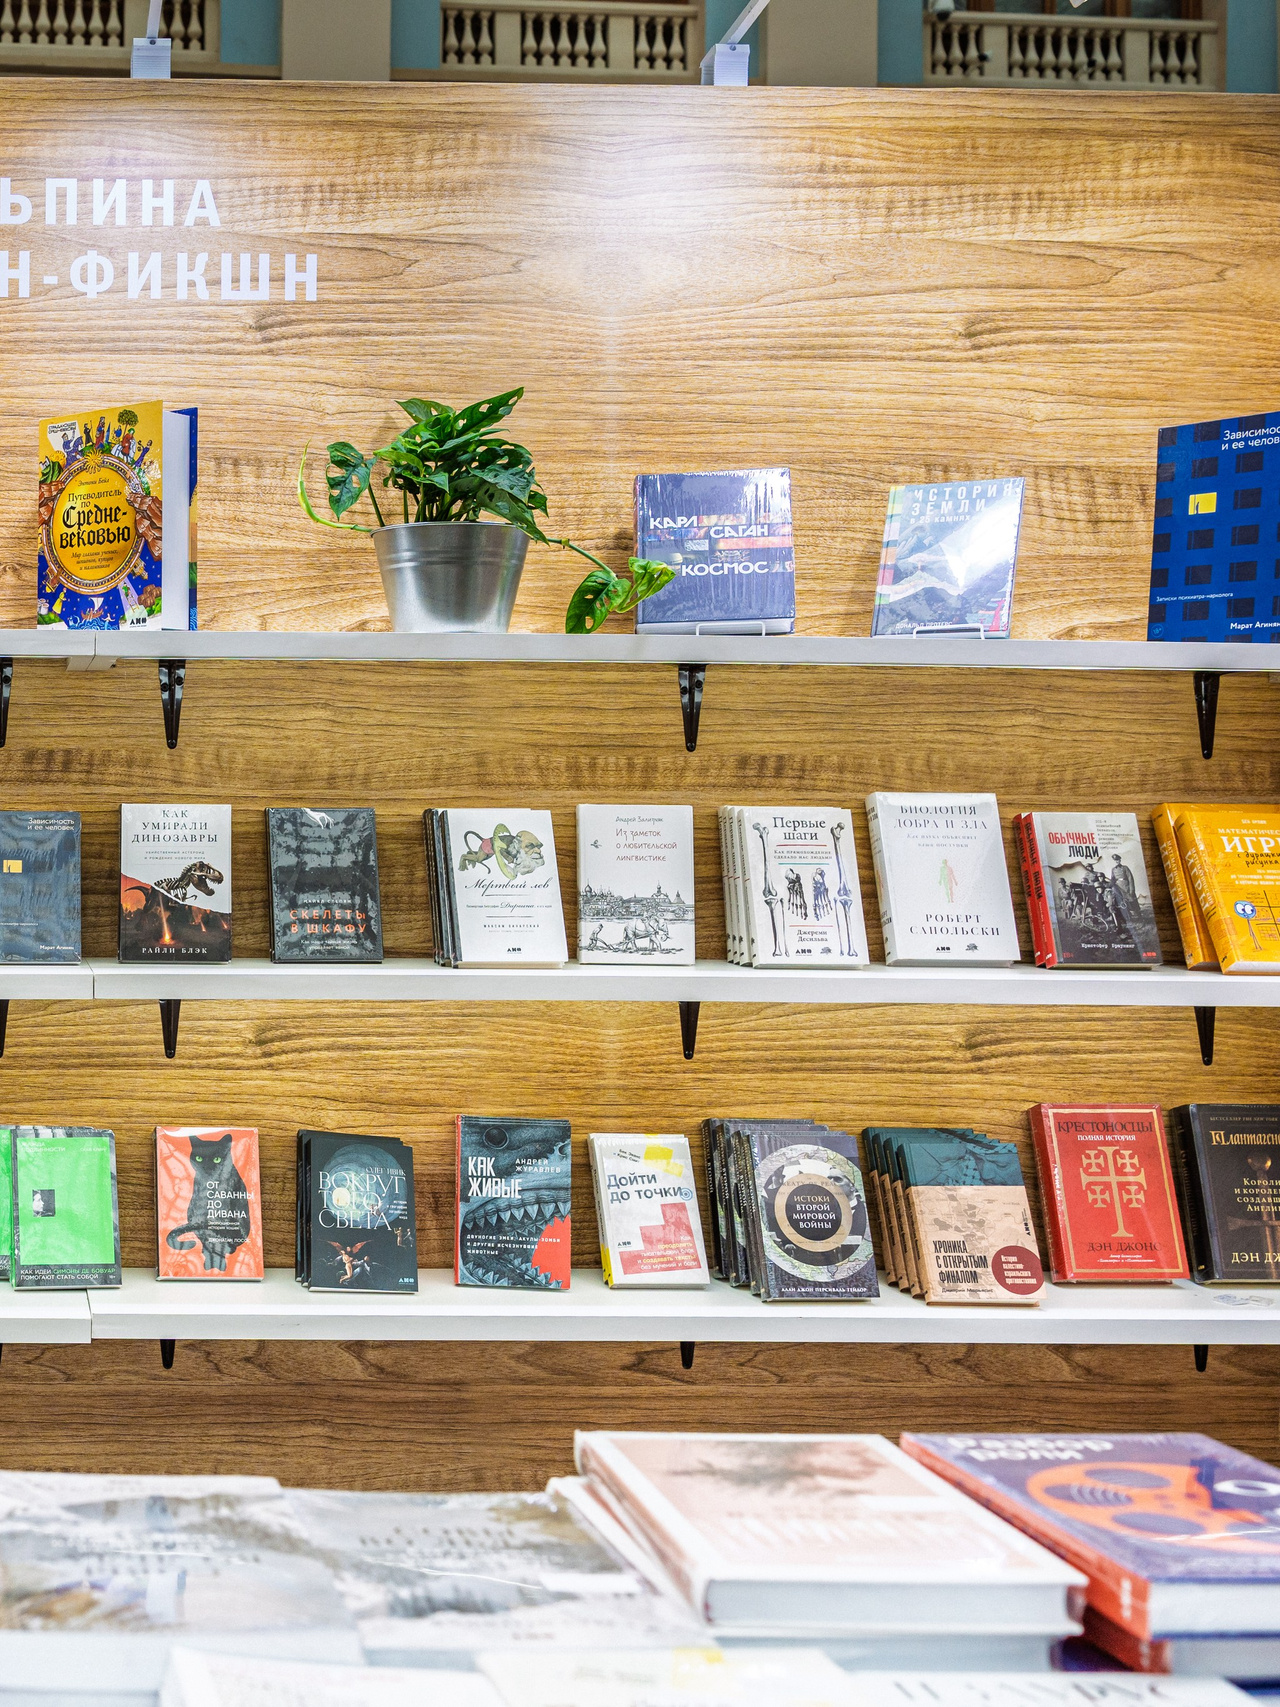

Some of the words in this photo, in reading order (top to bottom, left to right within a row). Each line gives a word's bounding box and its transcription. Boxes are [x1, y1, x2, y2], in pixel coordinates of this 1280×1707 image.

[68, 489, 122, 504] Путеводитель
[914, 484, 1013, 502] ИСТОРИЯ
[911, 499, 986, 515] ЗЕМЛИ
[62, 504, 127, 531] Средне-
[650, 515, 698, 529] КАРЛ
[934, 515, 971, 523] камнях
[709, 525, 769, 538] САГАН
[60, 526, 131, 549] вековью
[681, 561, 769, 577] КОСМОС
[1230, 621, 1253, 630] Марат
[162, 809, 189, 819] КАК
[900, 805, 977, 816] БИОЛОГИЯ
[28, 817, 75, 825] Зависимость
[142, 822, 208, 831] УМИРАЛИ
[772, 816, 827, 829] Первые
[893, 818, 939, 829] ДОБРА
[945, 819, 955, 829] И
[961, 820, 988, 830] ЗЛА
[131, 834, 218, 844] ДИНОЗАВРЫ
[615, 828, 628, 841] Из
[783, 831, 819, 842] шаги
[1048, 830, 1097, 845] ОБЫЧНЫЕ
[1068, 845, 1100, 859] ЛЮДИ
[289, 909, 366, 920] СКЕЛЕТЫ
[925, 913, 982, 924] РОБЕРТ
[291, 923, 299, 934] В
[307, 923, 366, 934] ШКАФУ
[909, 925, 1001, 936] САПОЛЬСКИ
[142, 946, 175, 954] РАЙЛИ
[1058, 1121, 1153, 1133] КРЕСТОНОСЦЫ
[468, 1156, 496, 1177] КАК
[515, 1157, 549, 1166] АНДРЕЙ
[366, 1166, 384, 1174] ОЛЕГ
[386, 1168, 406, 1176] ИВИК
[515, 1165, 561, 1174] ЖУРАВЛЕВ
[206, 1181, 220, 1189] ОТ
[318, 1171, 406, 1197] ВОКРУГ
[607, 1171, 658, 1190] Дойти
[468, 1177, 523, 1199] ЖИВЫЕ
[206, 1190, 254, 1200] САВАННЫ
[318, 1188, 381, 1210] ТОГО
[610, 1190, 631, 1204] до
[634, 1187, 682, 1200] точки
[793, 1195, 830, 1203] ИСТОКИ
[206, 1200, 222, 1210] ДО
[796, 1203, 831, 1211] ВТОРОЙ
[207, 1210, 247, 1219] ДИВАНА
[318, 1208, 392, 1231] СВЕТА
[792, 1212, 836, 1220] МИРОВОЙ
[799, 1221, 832, 1229] ВОЙНЫ
[932, 1240, 968, 1254] ХРОНИКА
[1087, 1242, 1112, 1253] ДЭН
[1116, 1242, 1161, 1252] ДЖОНС
[935, 1255, 942, 1269] С
[943, 1255, 989, 1269] ОТКРЫТЫМ
[1231, 1252, 1260, 1264] ДЭН
[938, 1270, 979, 1284] ФИНАЛОМ
